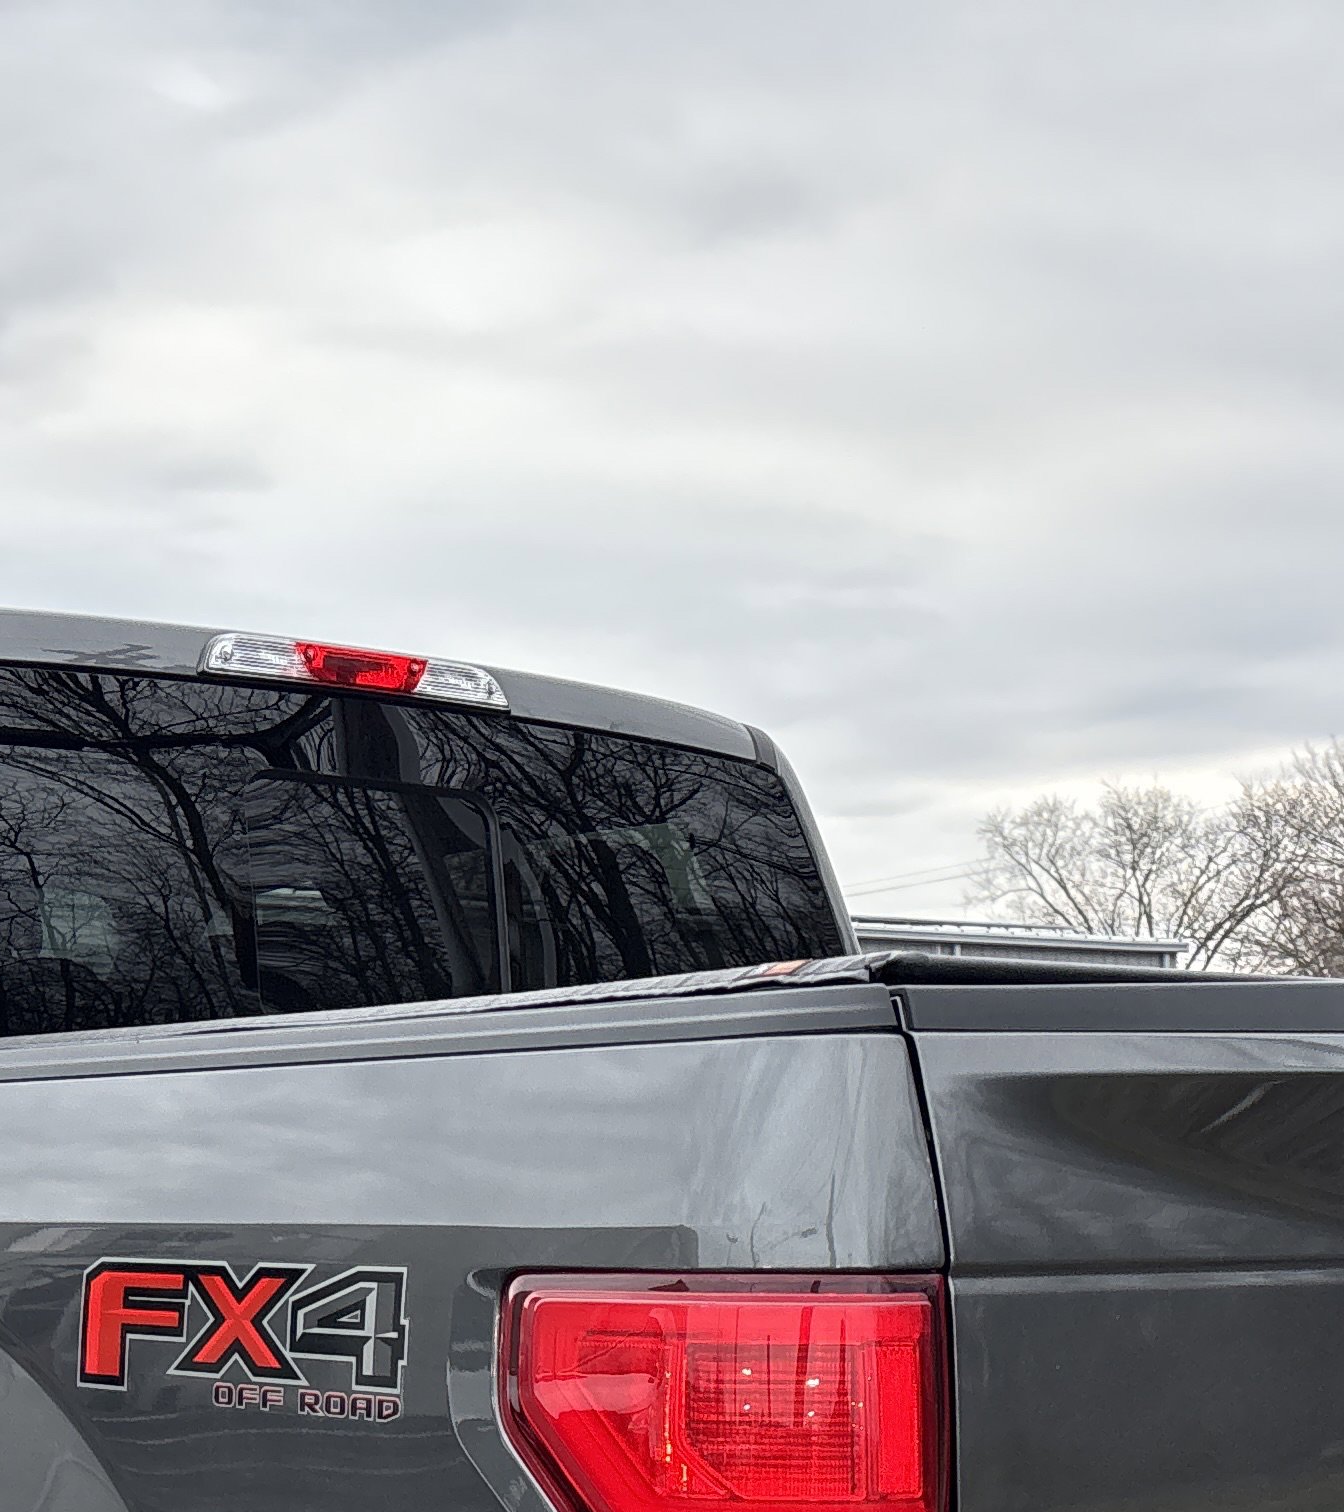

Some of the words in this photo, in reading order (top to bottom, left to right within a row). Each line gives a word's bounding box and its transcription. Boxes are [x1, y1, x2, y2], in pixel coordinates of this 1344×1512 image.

[77, 1257, 408, 1393] FX4
[212, 1382, 284, 1411] OFF
[297, 1389, 401, 1422] ROAD
